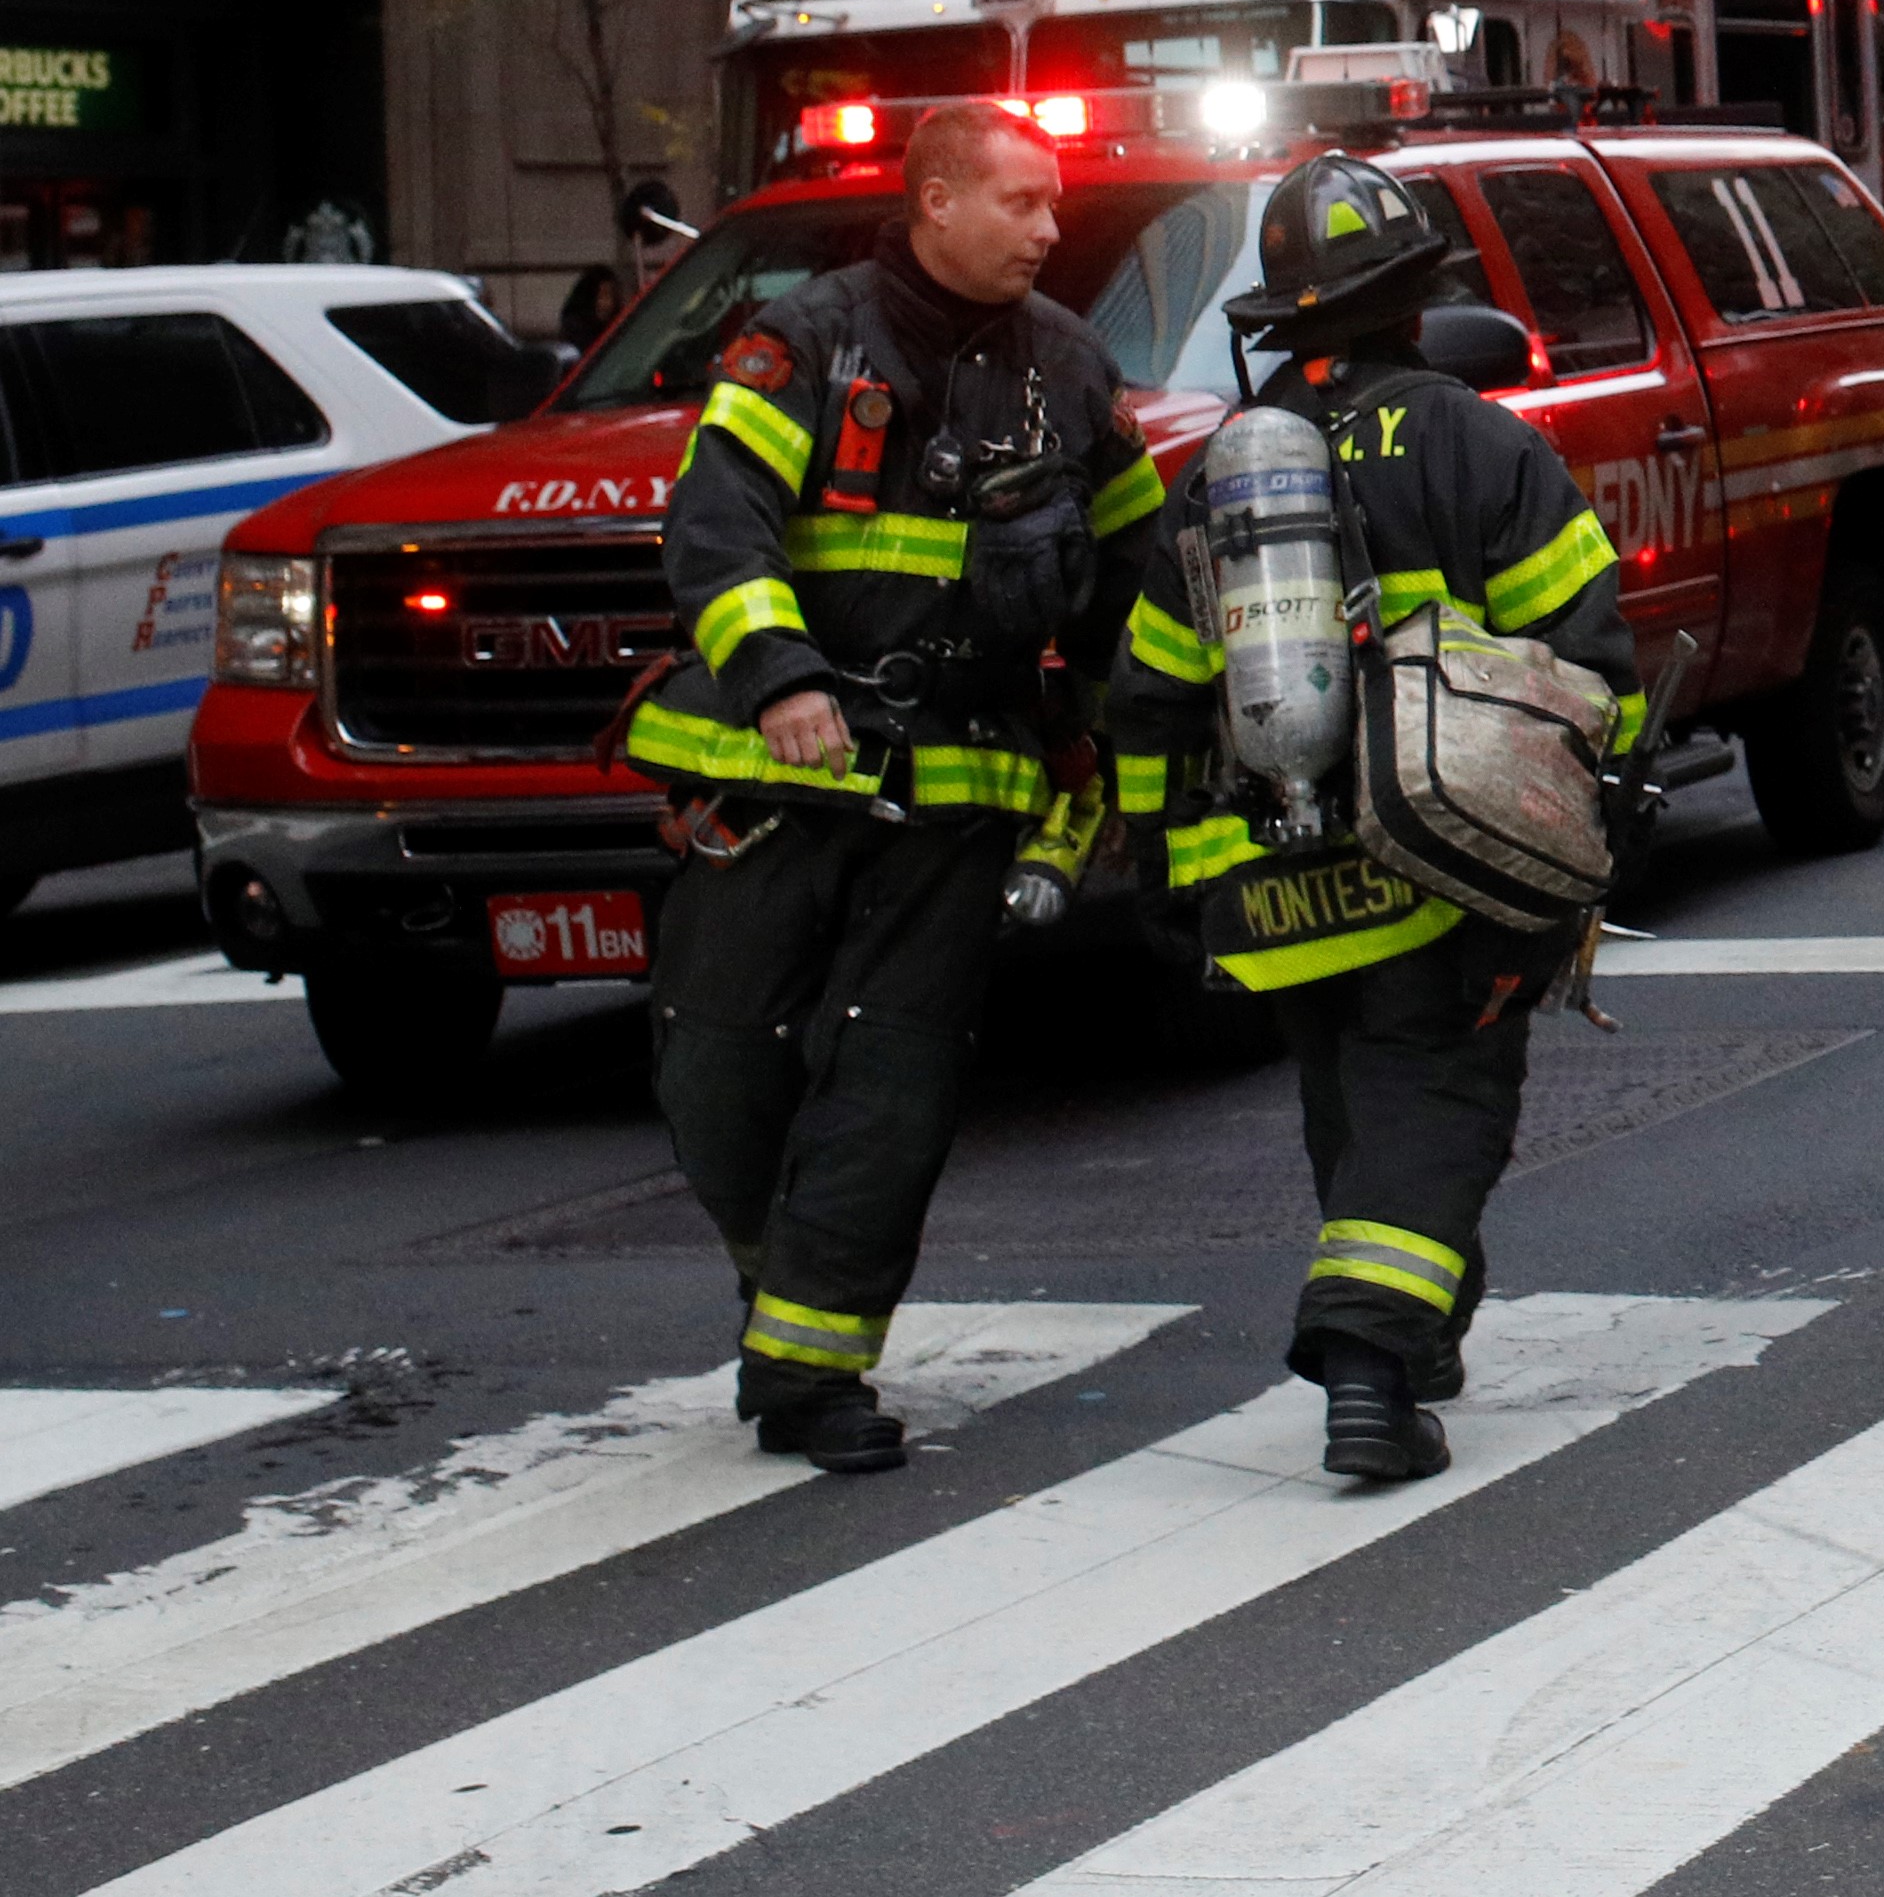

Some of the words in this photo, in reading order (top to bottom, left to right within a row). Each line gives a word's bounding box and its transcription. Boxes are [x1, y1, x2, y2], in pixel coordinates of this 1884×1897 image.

[1594, 450, 1700, 560] FDNY
[1246, 597, 1320, 621] SCOTT
[463, 612, 676, 668] GMC
[546, 905, 600, 961] 11
